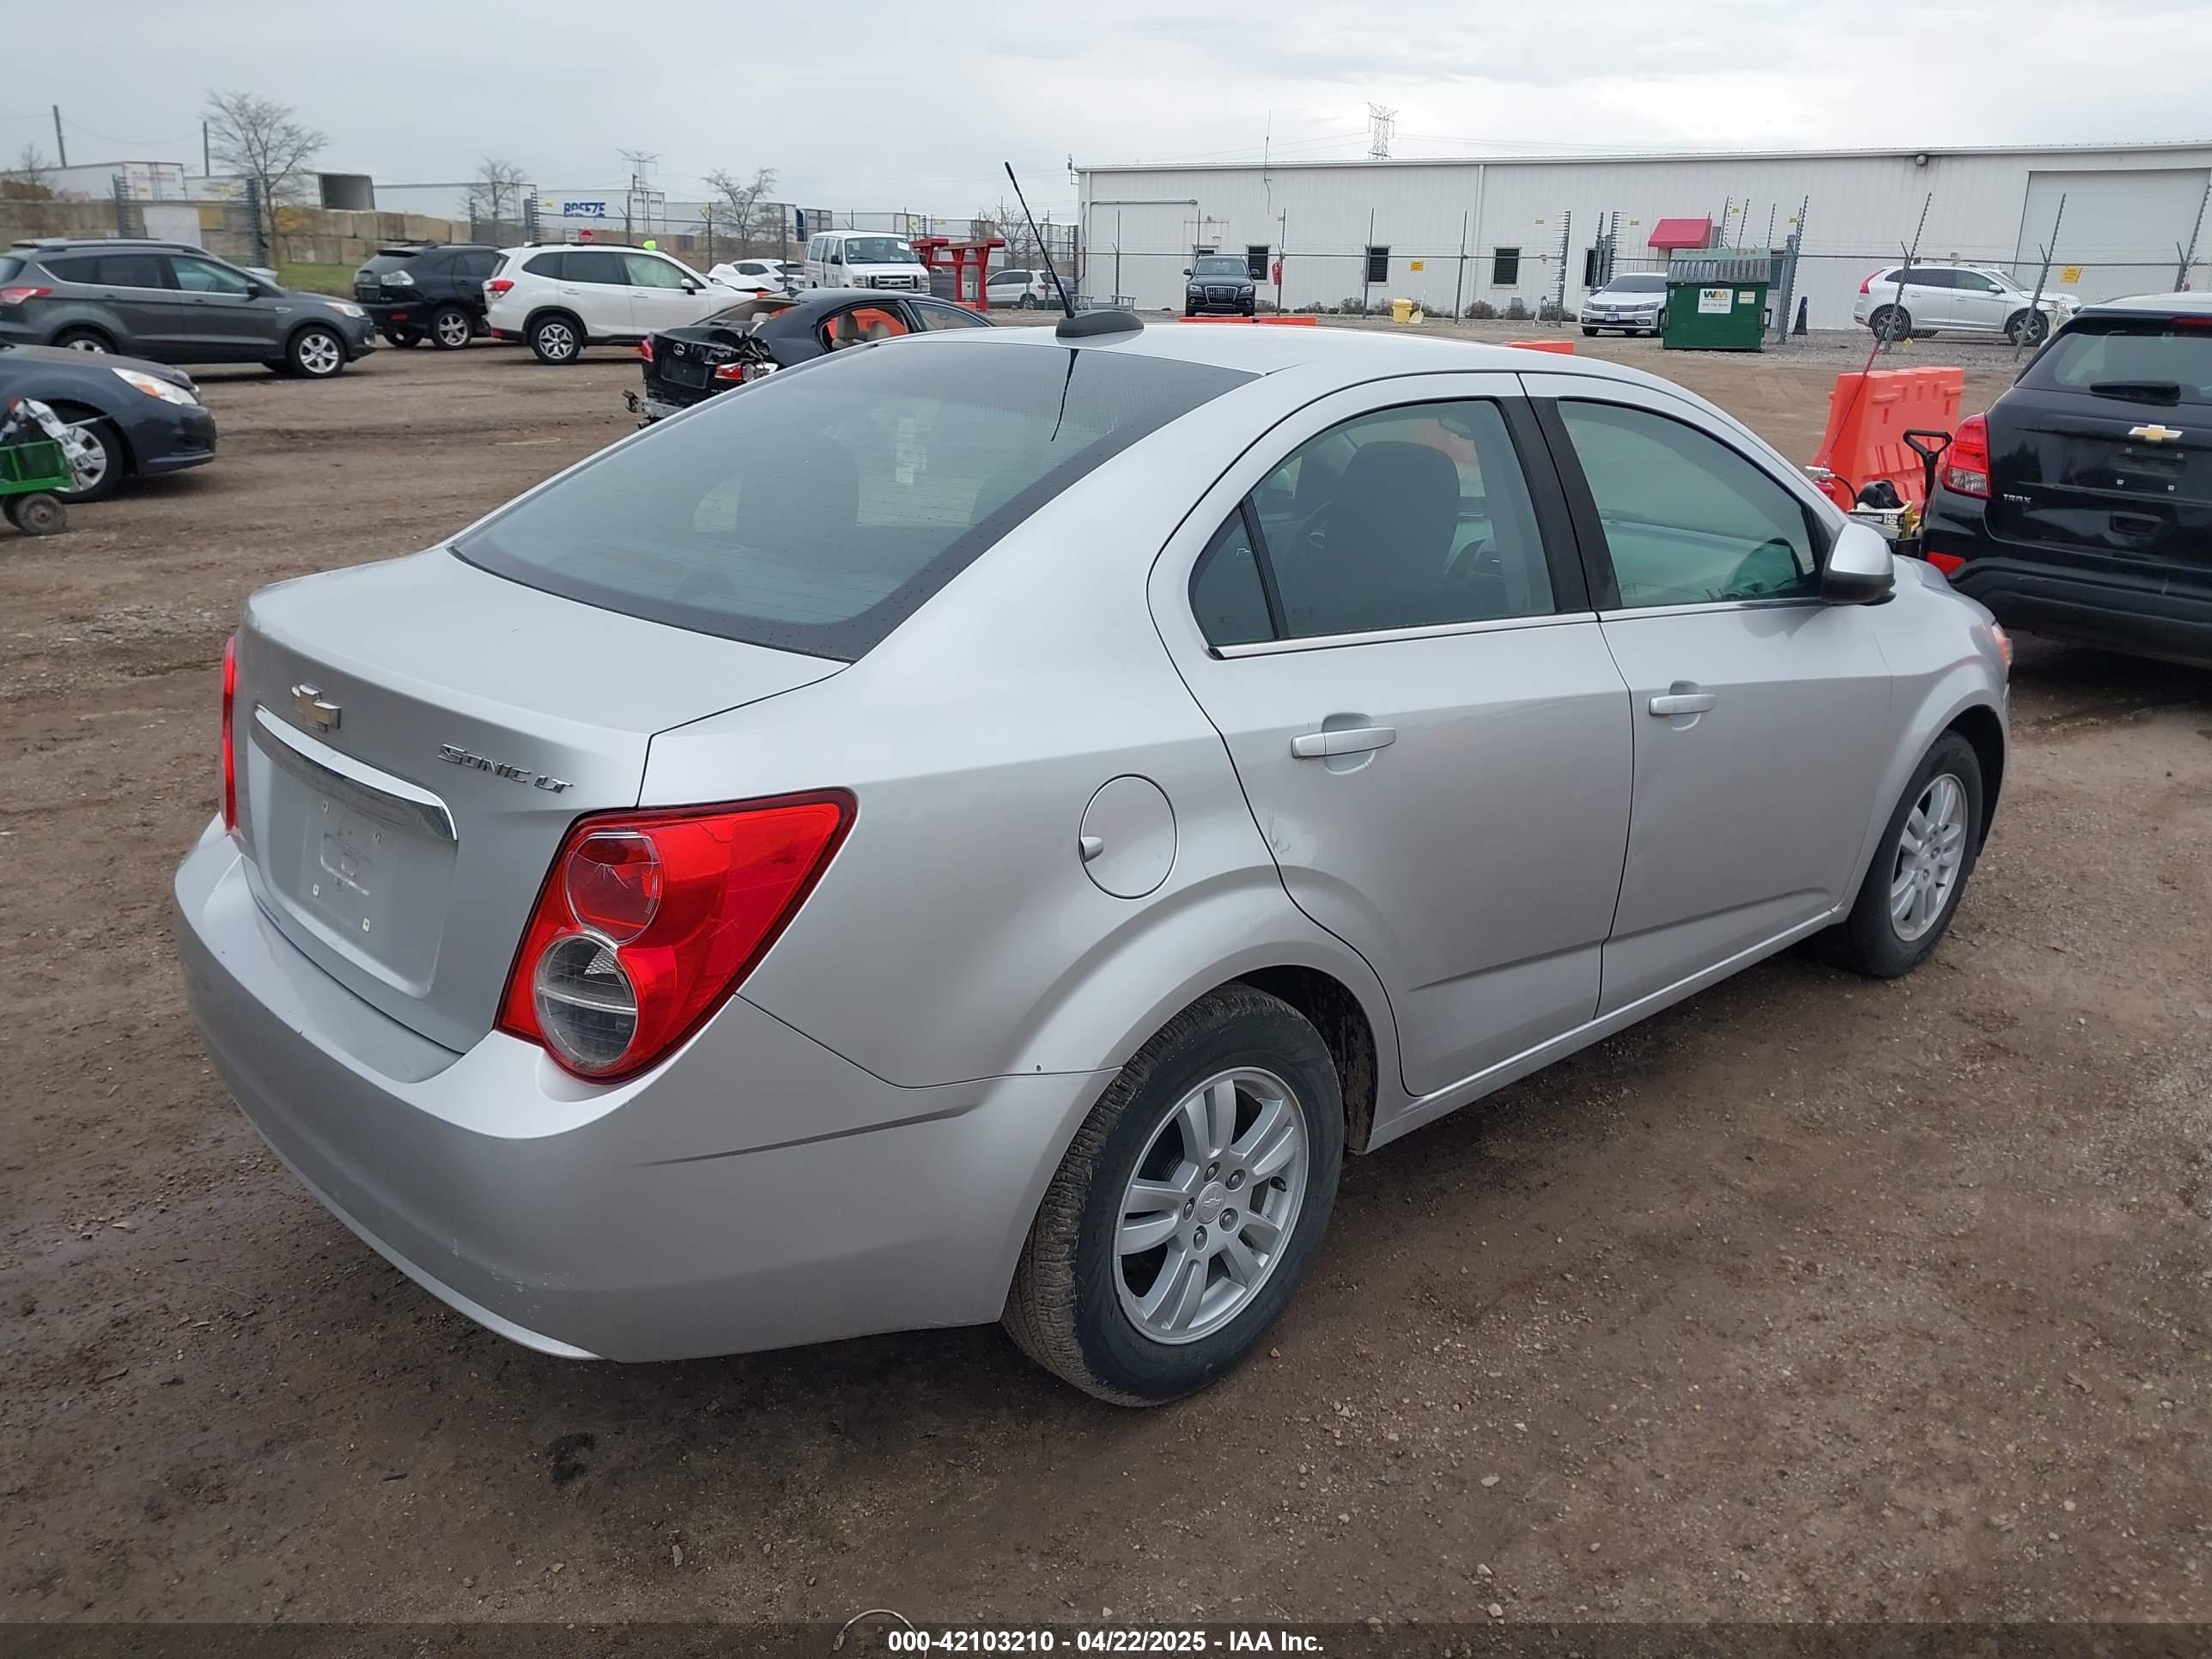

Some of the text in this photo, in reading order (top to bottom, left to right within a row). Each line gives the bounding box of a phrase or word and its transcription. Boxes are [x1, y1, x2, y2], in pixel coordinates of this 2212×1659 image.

[2002, 494, 2032, 503] TRAX
[436, 744, 574, 793] SONIC LT
